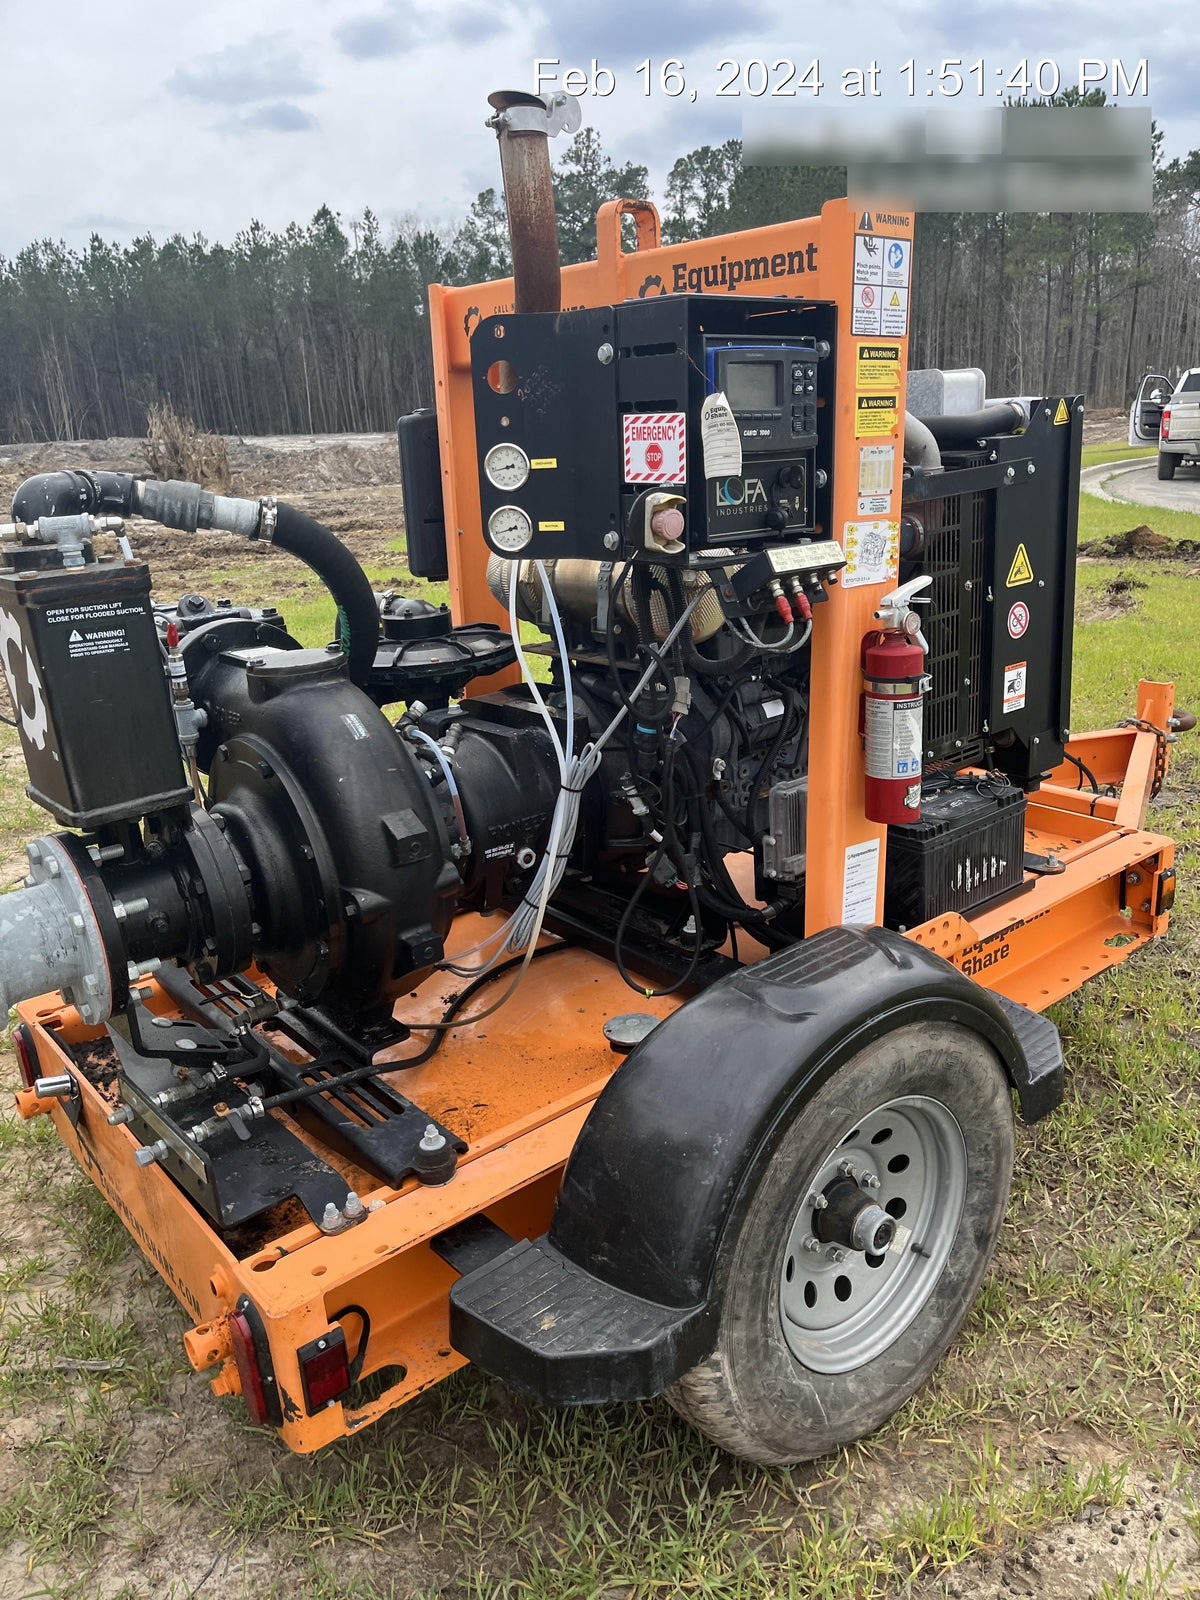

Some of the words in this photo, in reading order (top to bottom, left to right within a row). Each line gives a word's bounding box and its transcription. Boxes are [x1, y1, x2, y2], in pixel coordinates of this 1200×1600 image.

[875, 213, 910, 227] WARNING
[672, 242, 818, 294] Equipment
[869, 350, 896, 359] WARNING
[868, 399, 893, 407] WARNING
[631, 425, 677, 441] EMERGENCY
[646, 452, 662, 462] STOP
[716, 477, 768, 507] LOFA
[716, 504, 769, 517] INDUSTRIES
[46, 608, 65, 616] OPEN
[80, 604, 109, 612] SUCTION
[47, 615, 70, 623] CLOSE
[85, 610, 116, 619] FLOODED
[116, 607, 144, 615] SUCTION
[85, 628, 126, 640] WARNING!
[69, 641, 95, 649] OPERATORS
[69, 646, 98, 654] UNDERSTAND
[91, 648, 115, 656] OPERATION
[961, 943, 1010, 976] Share
